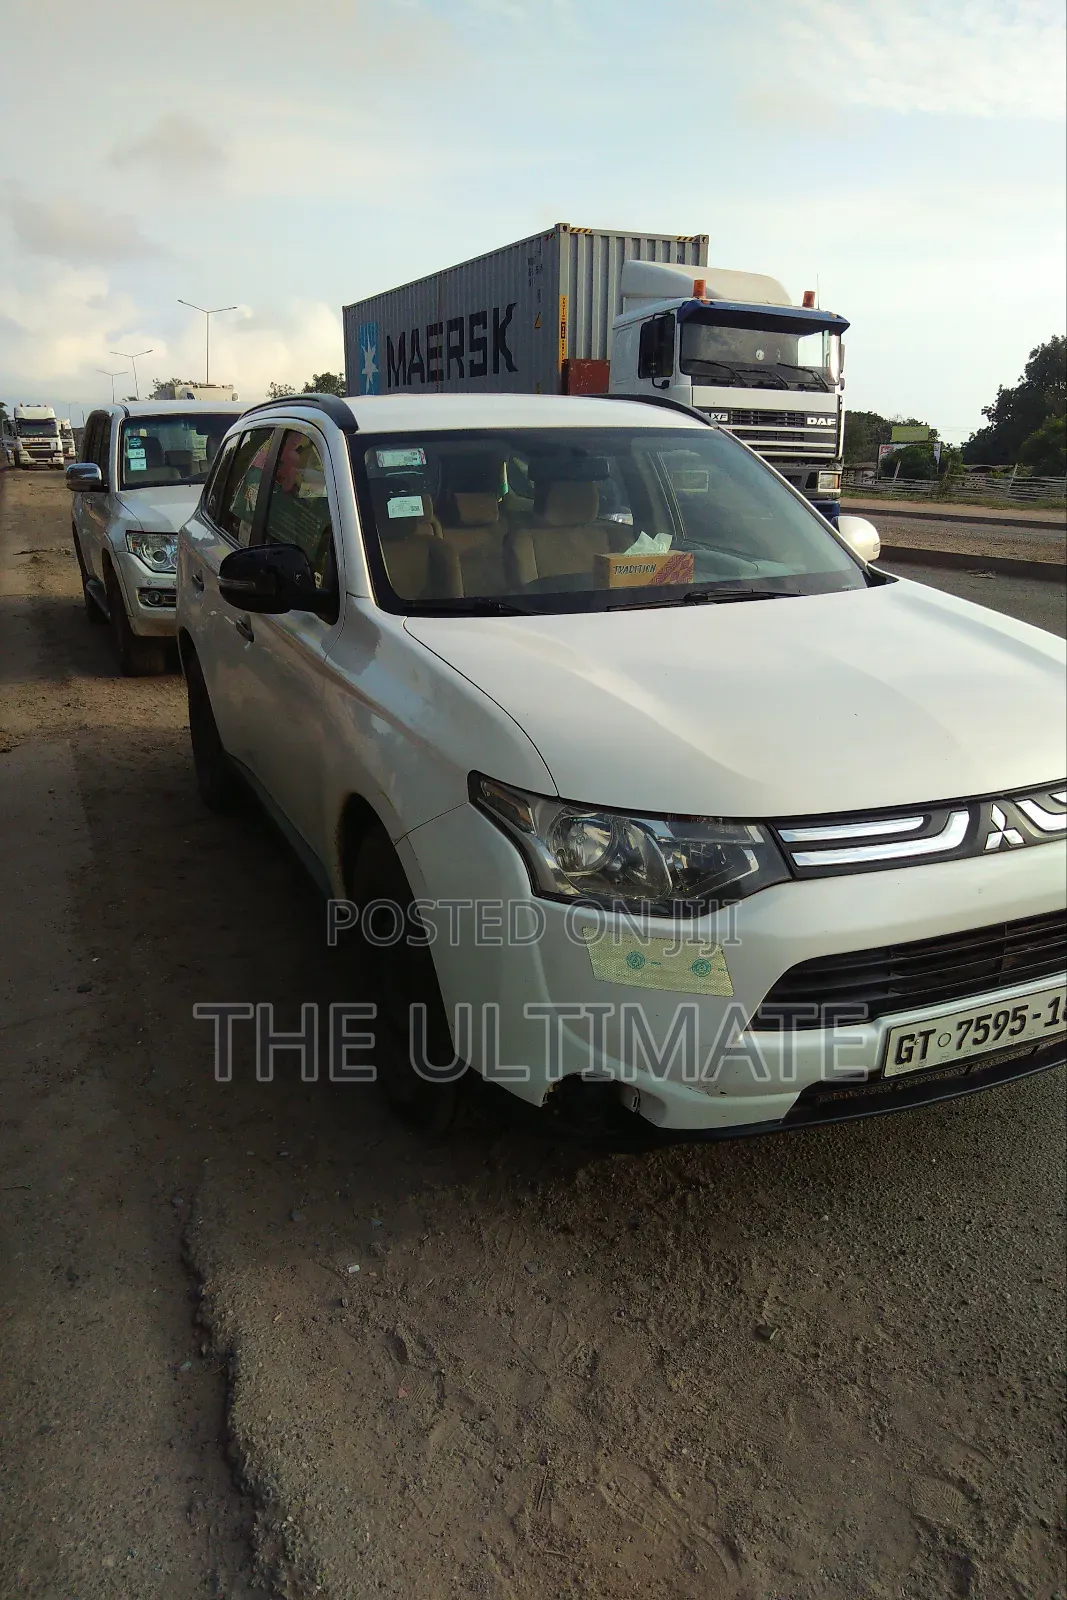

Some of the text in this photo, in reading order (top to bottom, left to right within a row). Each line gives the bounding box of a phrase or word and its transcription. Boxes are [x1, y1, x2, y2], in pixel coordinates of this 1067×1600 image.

[386, 302, 519, 388] MAERSK
[712, 413, 728, 421] XF
[806, 417, 837, 426] DAF
[895, 1028, 936, 1066] GT
